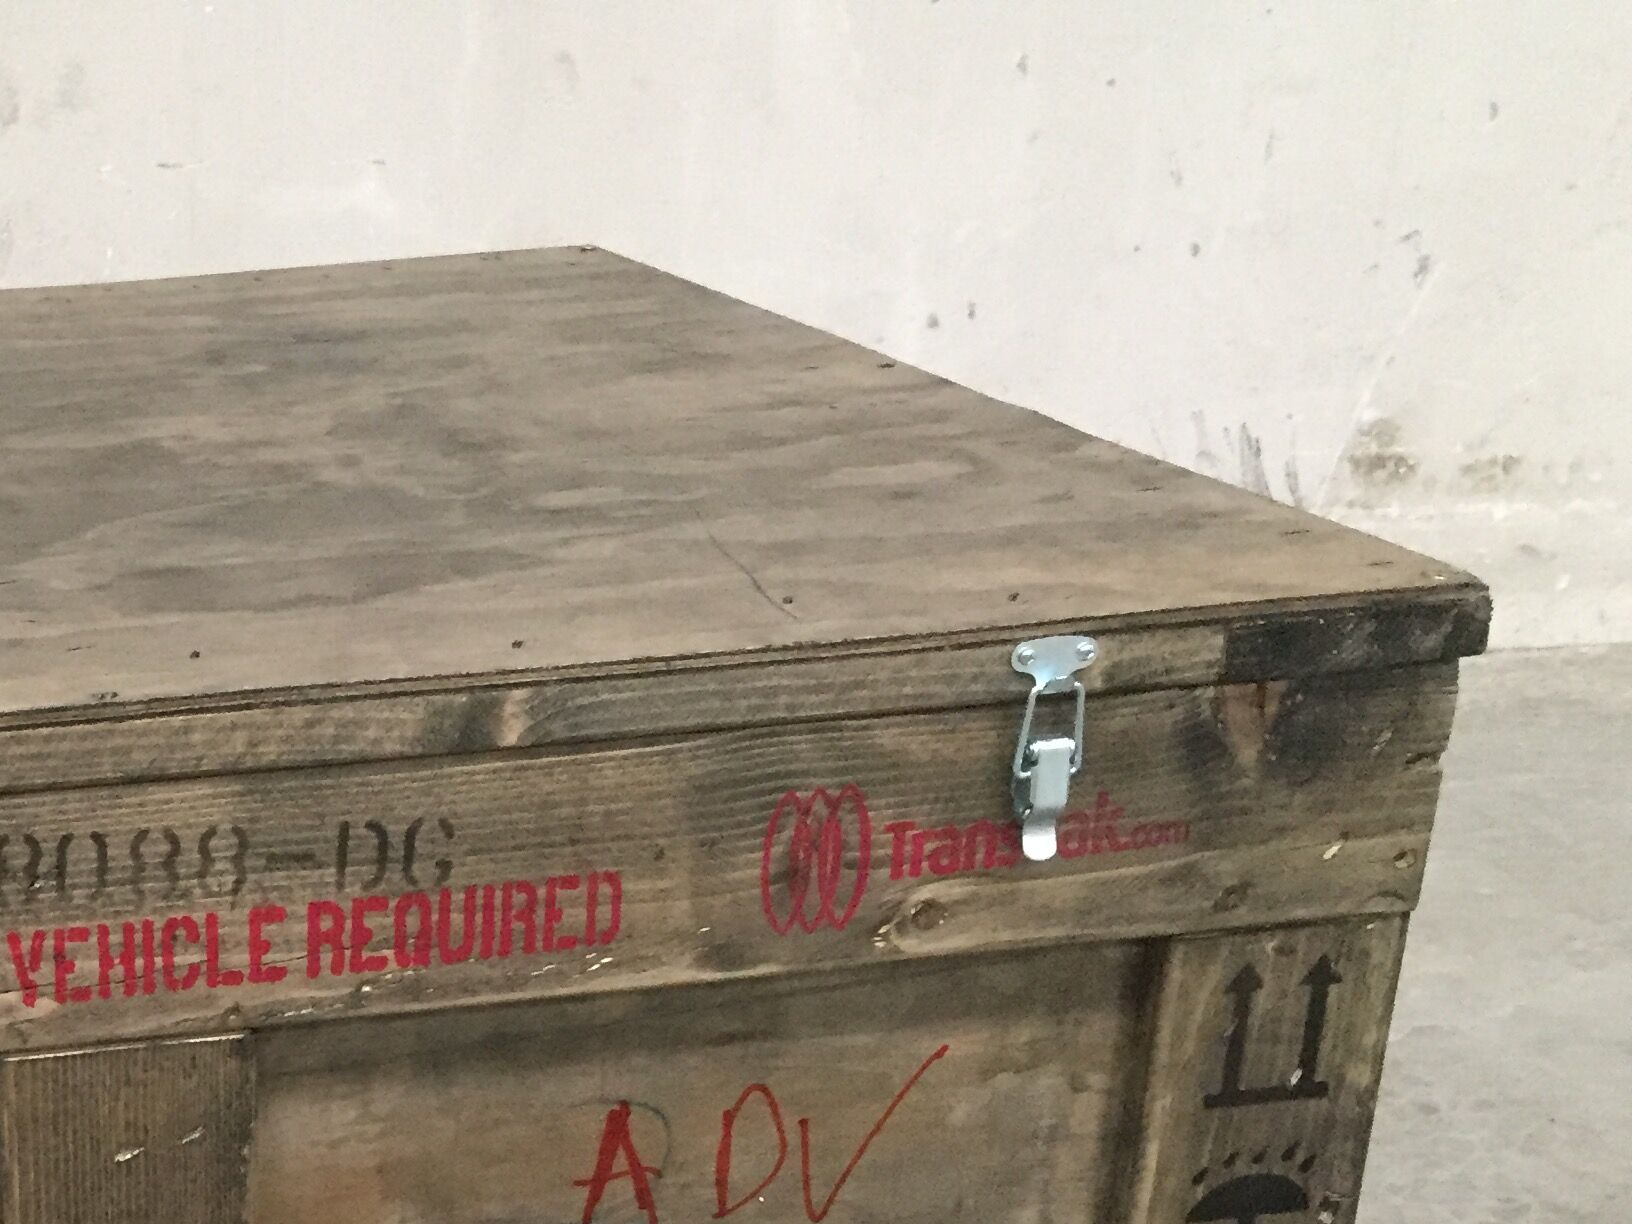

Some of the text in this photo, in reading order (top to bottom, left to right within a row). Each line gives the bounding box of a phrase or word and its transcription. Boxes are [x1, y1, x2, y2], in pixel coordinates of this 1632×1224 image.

[883, 791, 1191, 881] Transak.com
[6, 904, 288, 1009] VEHICLE
[306, 869, 624, 980] REQUIRED
